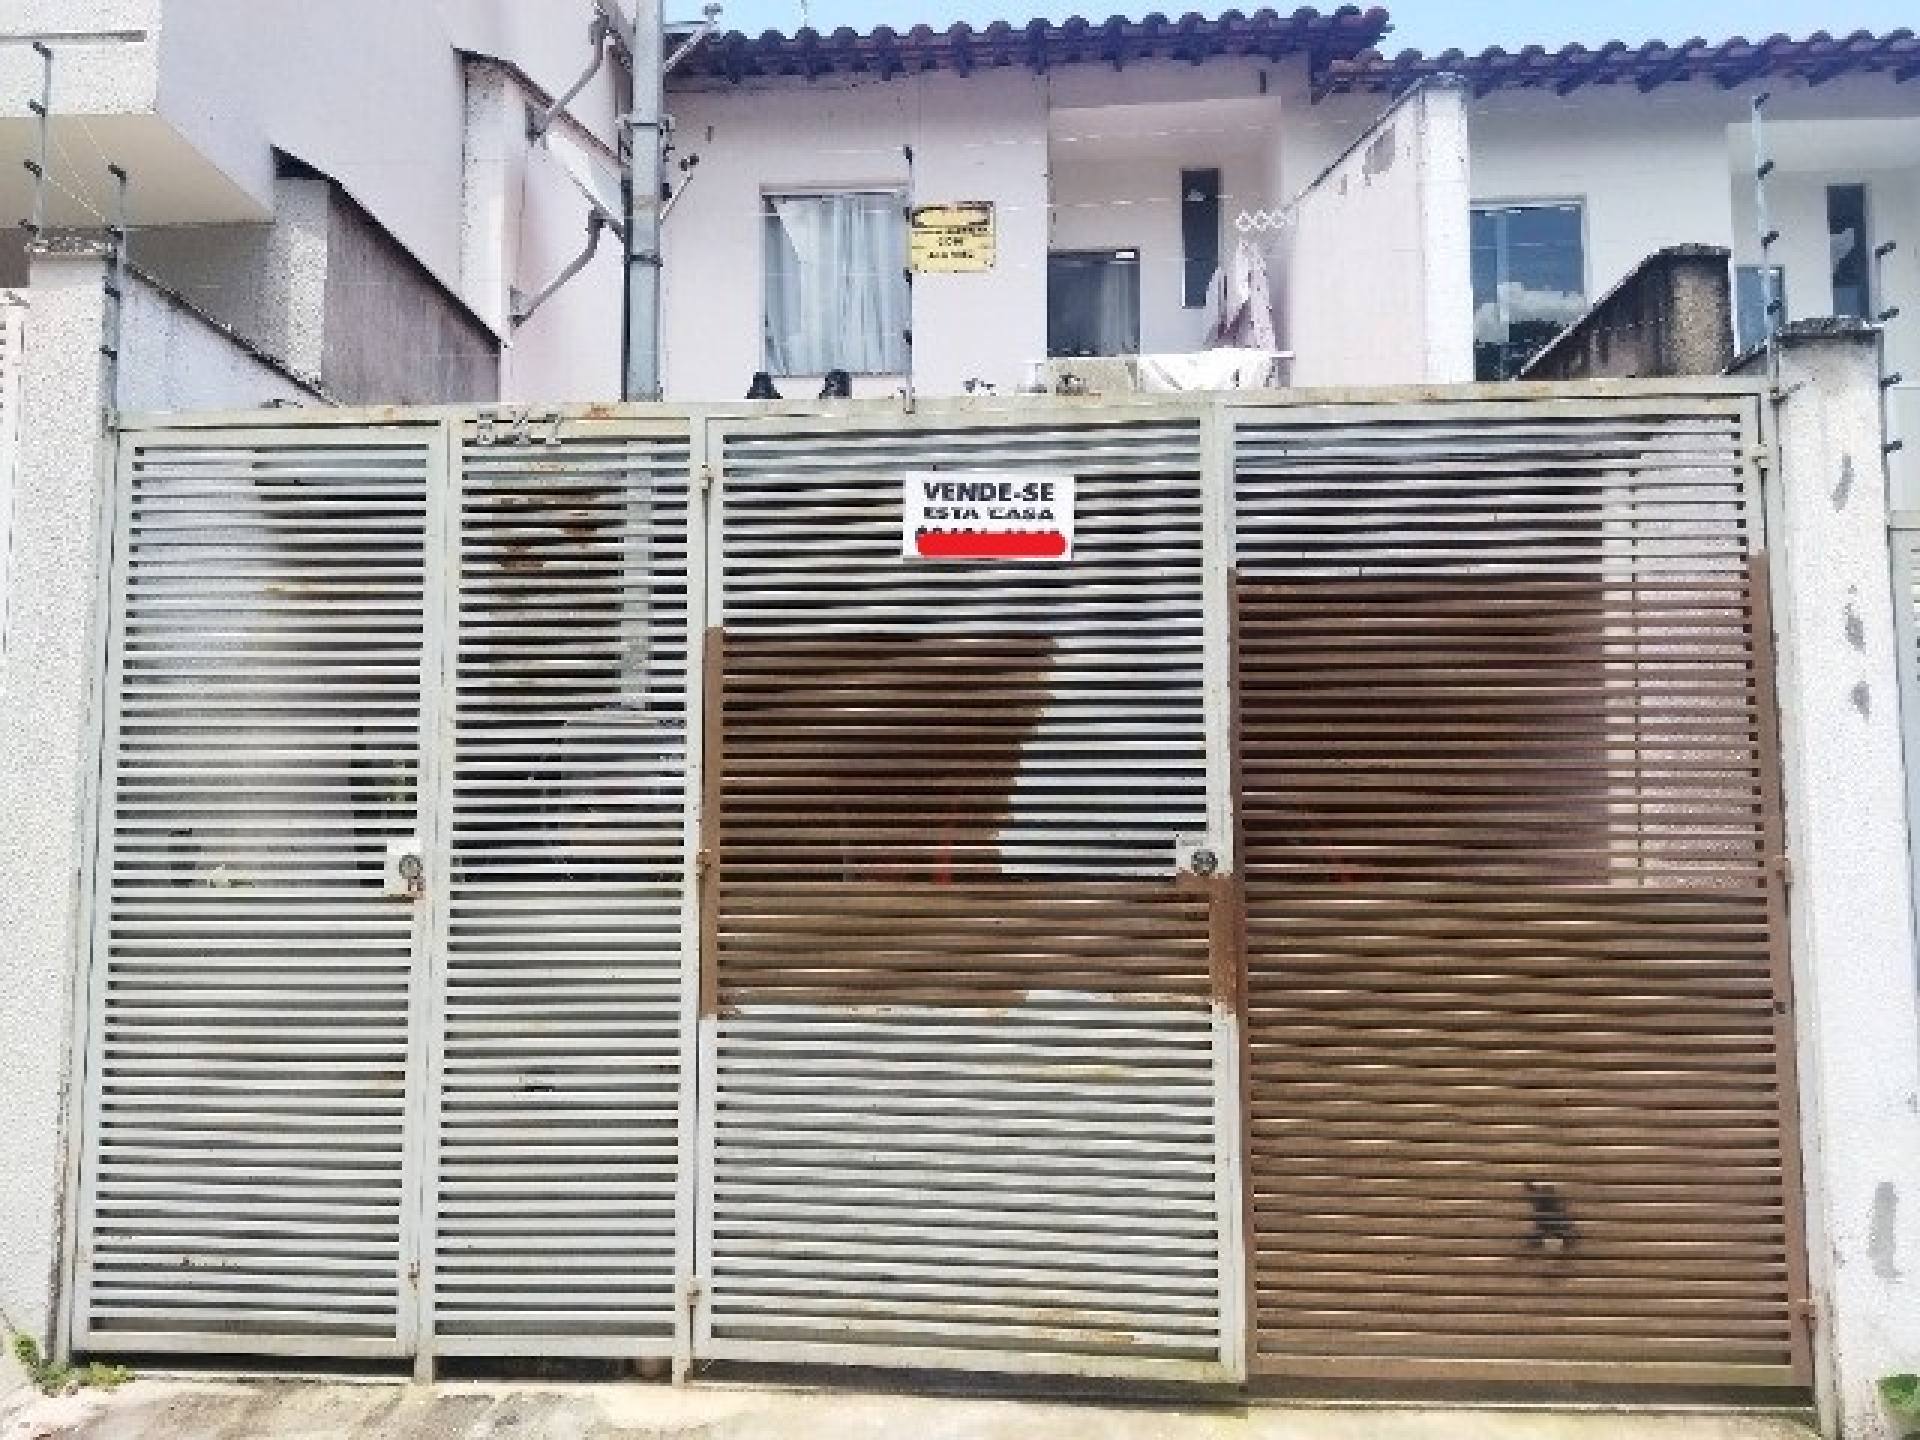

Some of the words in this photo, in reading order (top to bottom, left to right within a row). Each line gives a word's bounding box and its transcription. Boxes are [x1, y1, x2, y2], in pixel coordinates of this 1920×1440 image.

[923, 482, 1054, 502] VENDE-SE
[923, 506, 979, 520] ESTA
[987, 506, 1055, 520] CASA
